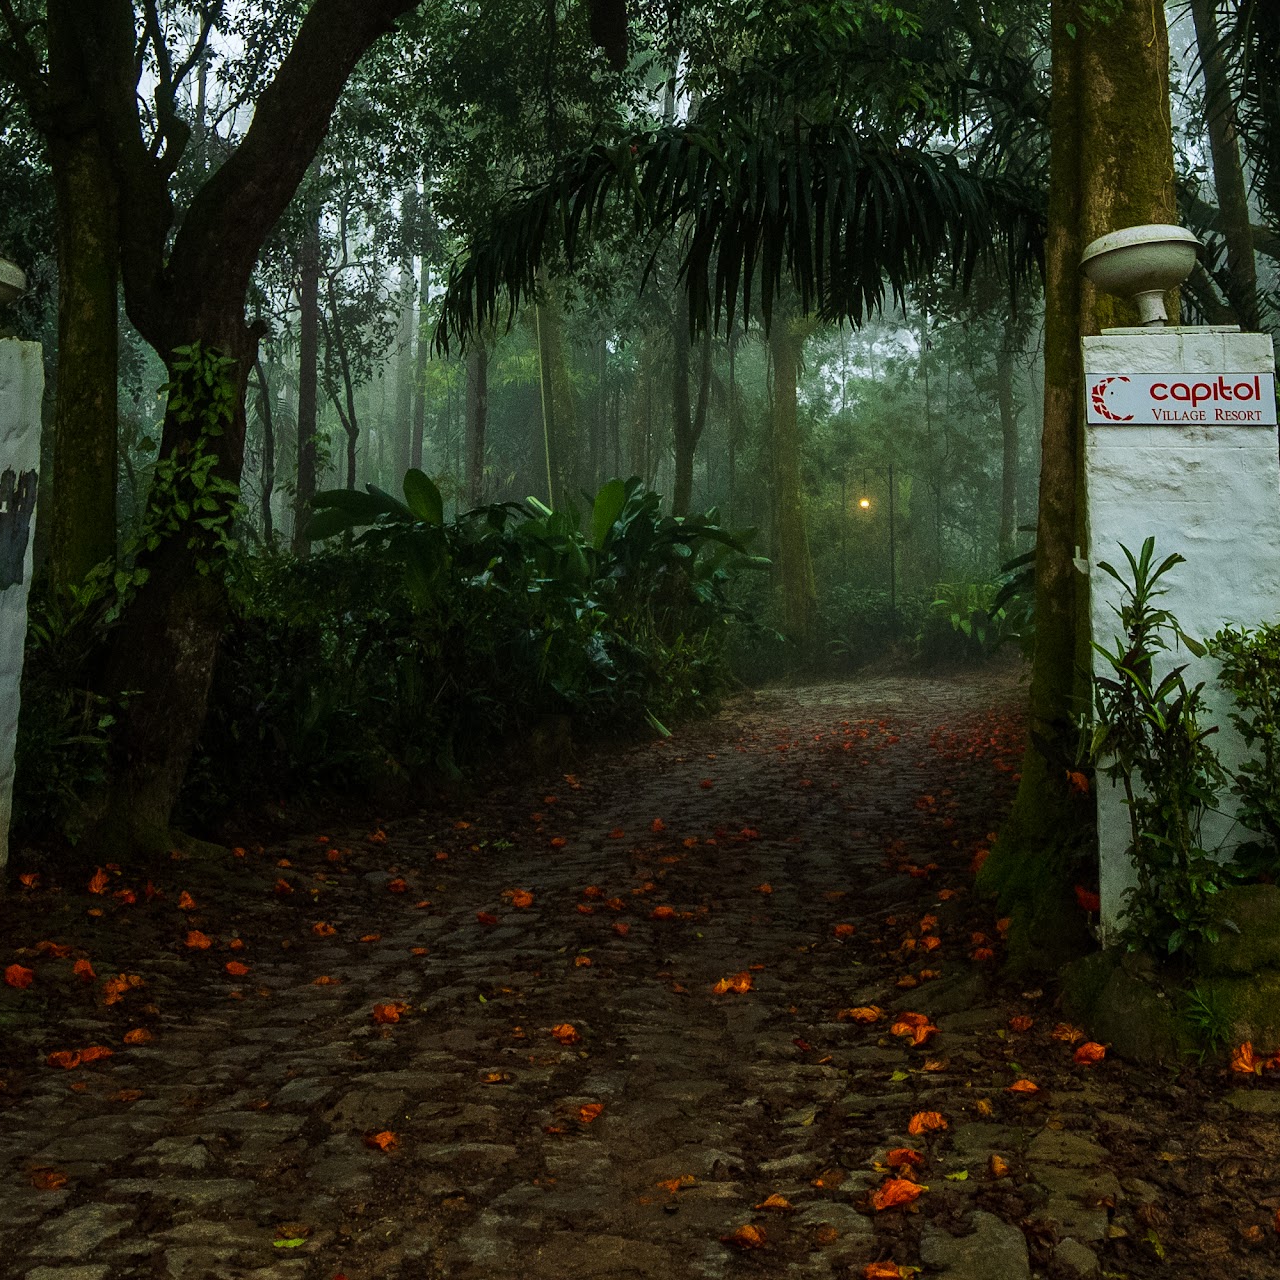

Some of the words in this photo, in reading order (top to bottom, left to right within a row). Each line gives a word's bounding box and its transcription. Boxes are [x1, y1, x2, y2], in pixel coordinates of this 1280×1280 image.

[1149, 375, 1261, 407] capitol
[1151, 408, 1207, 421] VILLAGE
[1215, 408, 1262, 421] RESORT
